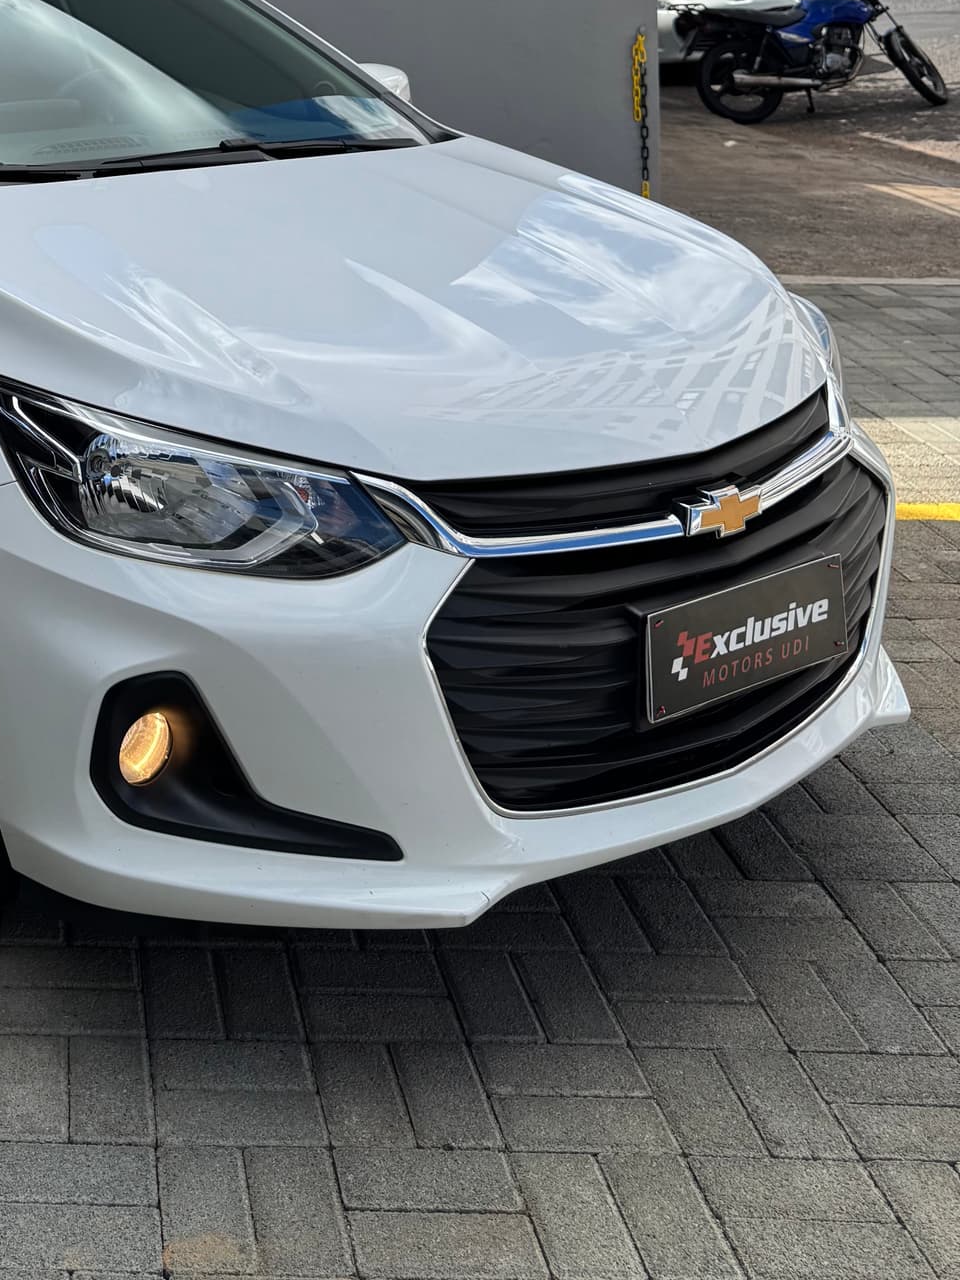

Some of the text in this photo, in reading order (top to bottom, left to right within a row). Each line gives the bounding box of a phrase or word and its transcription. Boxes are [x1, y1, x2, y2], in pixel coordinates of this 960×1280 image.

[694, 599, 828, 664] Exclusive
[703, 636, 809, 687] MOTORS UDI
